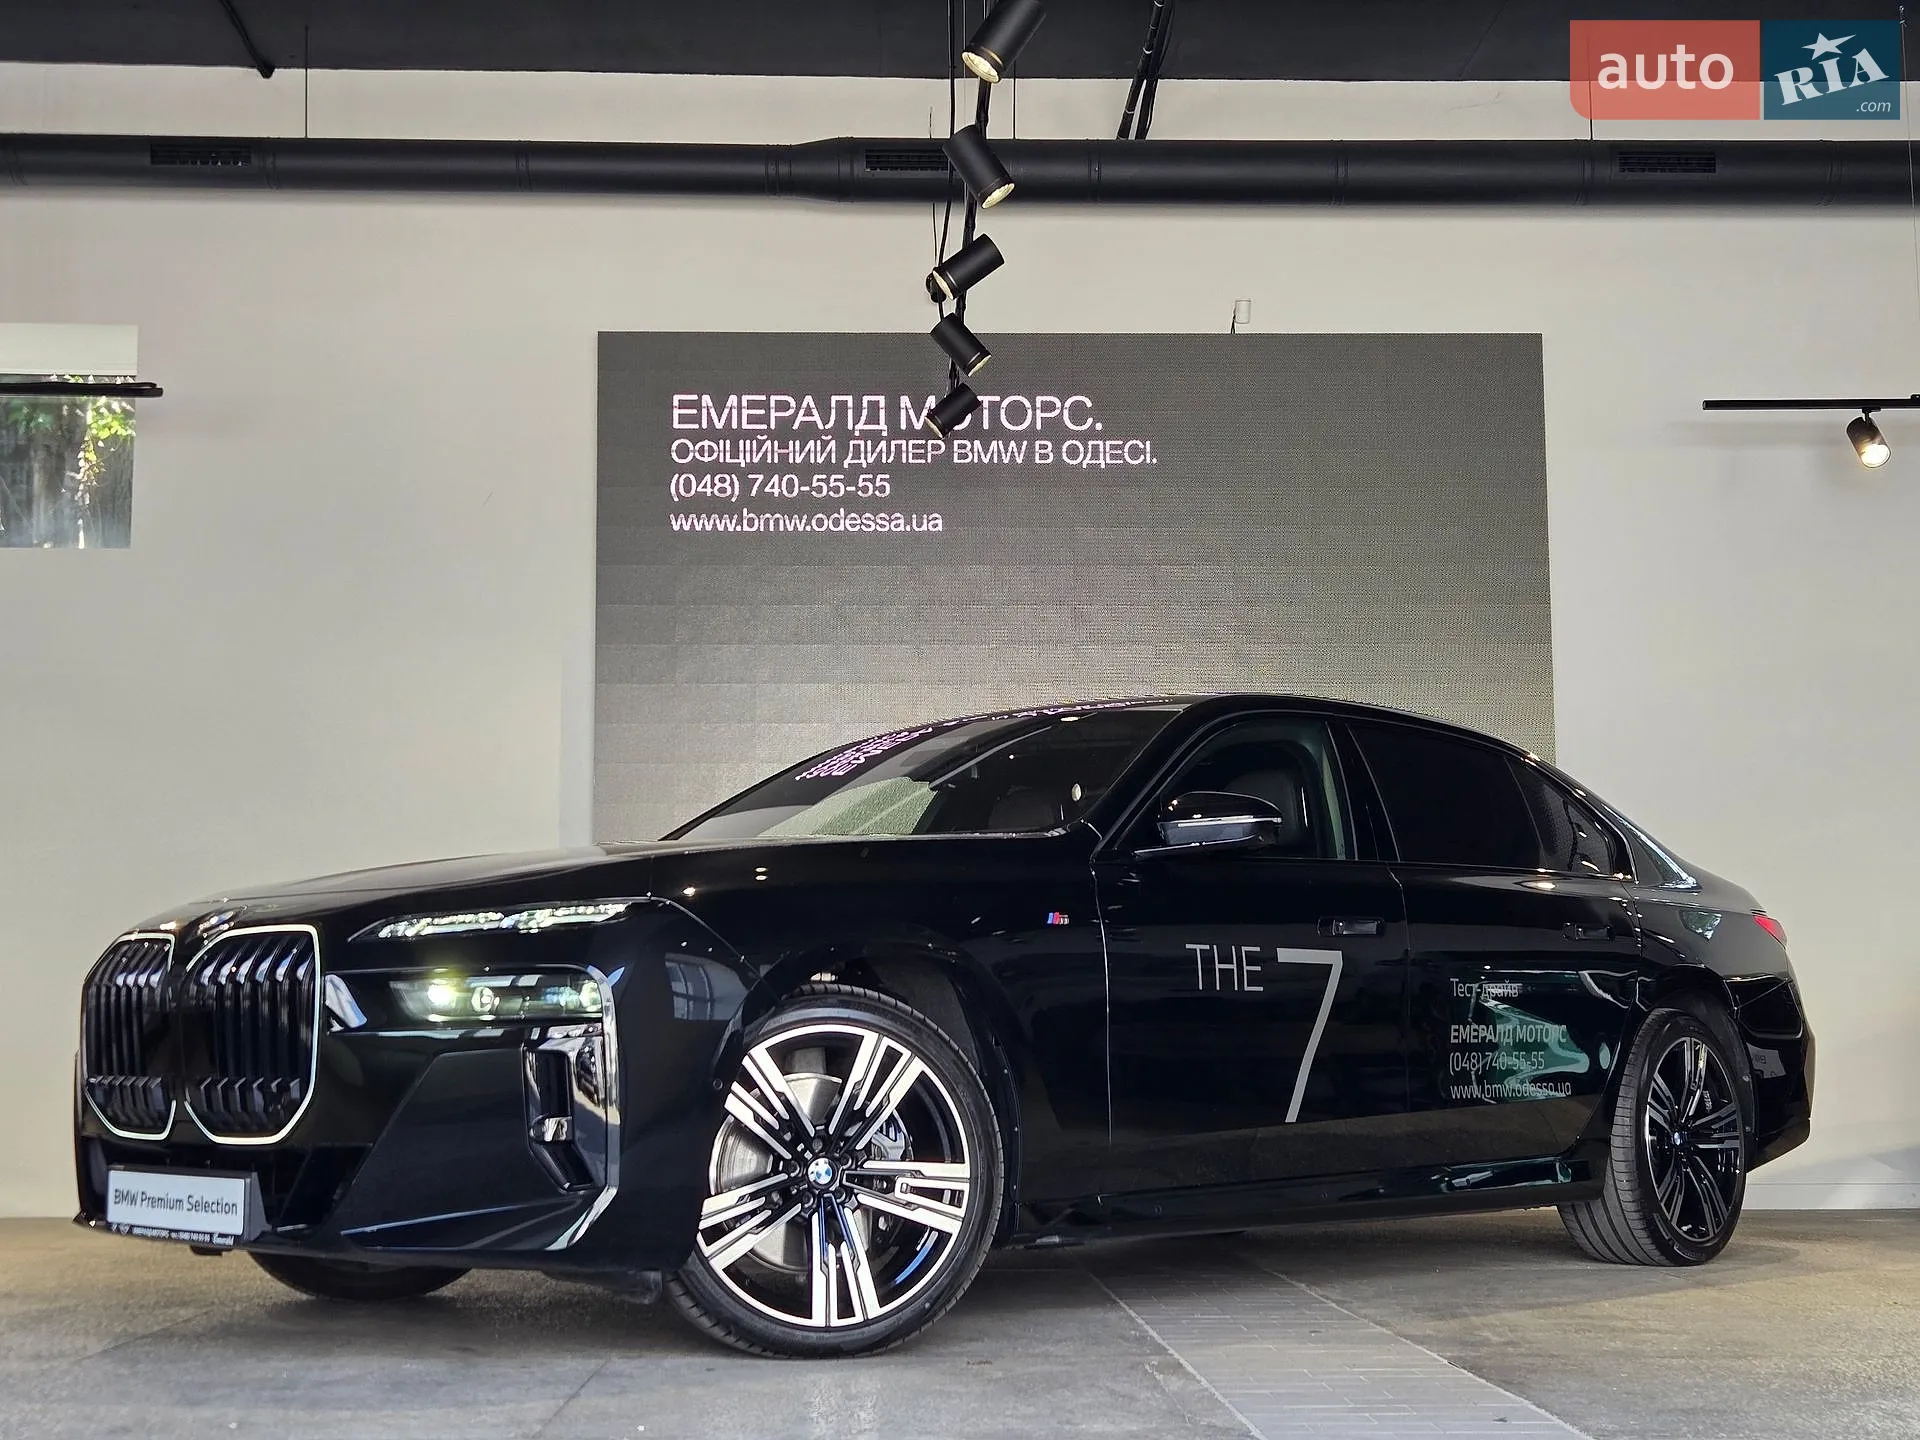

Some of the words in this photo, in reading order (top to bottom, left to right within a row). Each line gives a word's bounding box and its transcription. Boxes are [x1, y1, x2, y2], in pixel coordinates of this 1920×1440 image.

[672, 394, 888, 436] ЕМЕРАЛД
[670, 435, 836, 467] ОФІЦІЙНИЙ
[843, 439, 946, 468] ДИЛЕР
[953, 439, 1027, 464] BMW
[1061, 439, 1158, 468] ОДЕСІ.
[670, 473, 741, 501] (048)
[747, 473, 892, 498] 740-55-55
[669, 508, 944, 533] www.bmw.odessa.ua
[1186, 943, 1263, 992] THE
[1276, 947, 1344, 1123] 7
[1450, 1024, 1513, 1046] ЕМЕРАЛД
[1449, 1051, 1483, 1076] (048)
[1485, 1051, 1545, 1071] 740-55-55
[1450, 1080, 1572, 1099] www.bmw.odessa.ua
[113, 1188, 139, 1207] BMW
[139, 1191, 184, 1211] Premium
[186, 1194, 238, 1216] Selection
